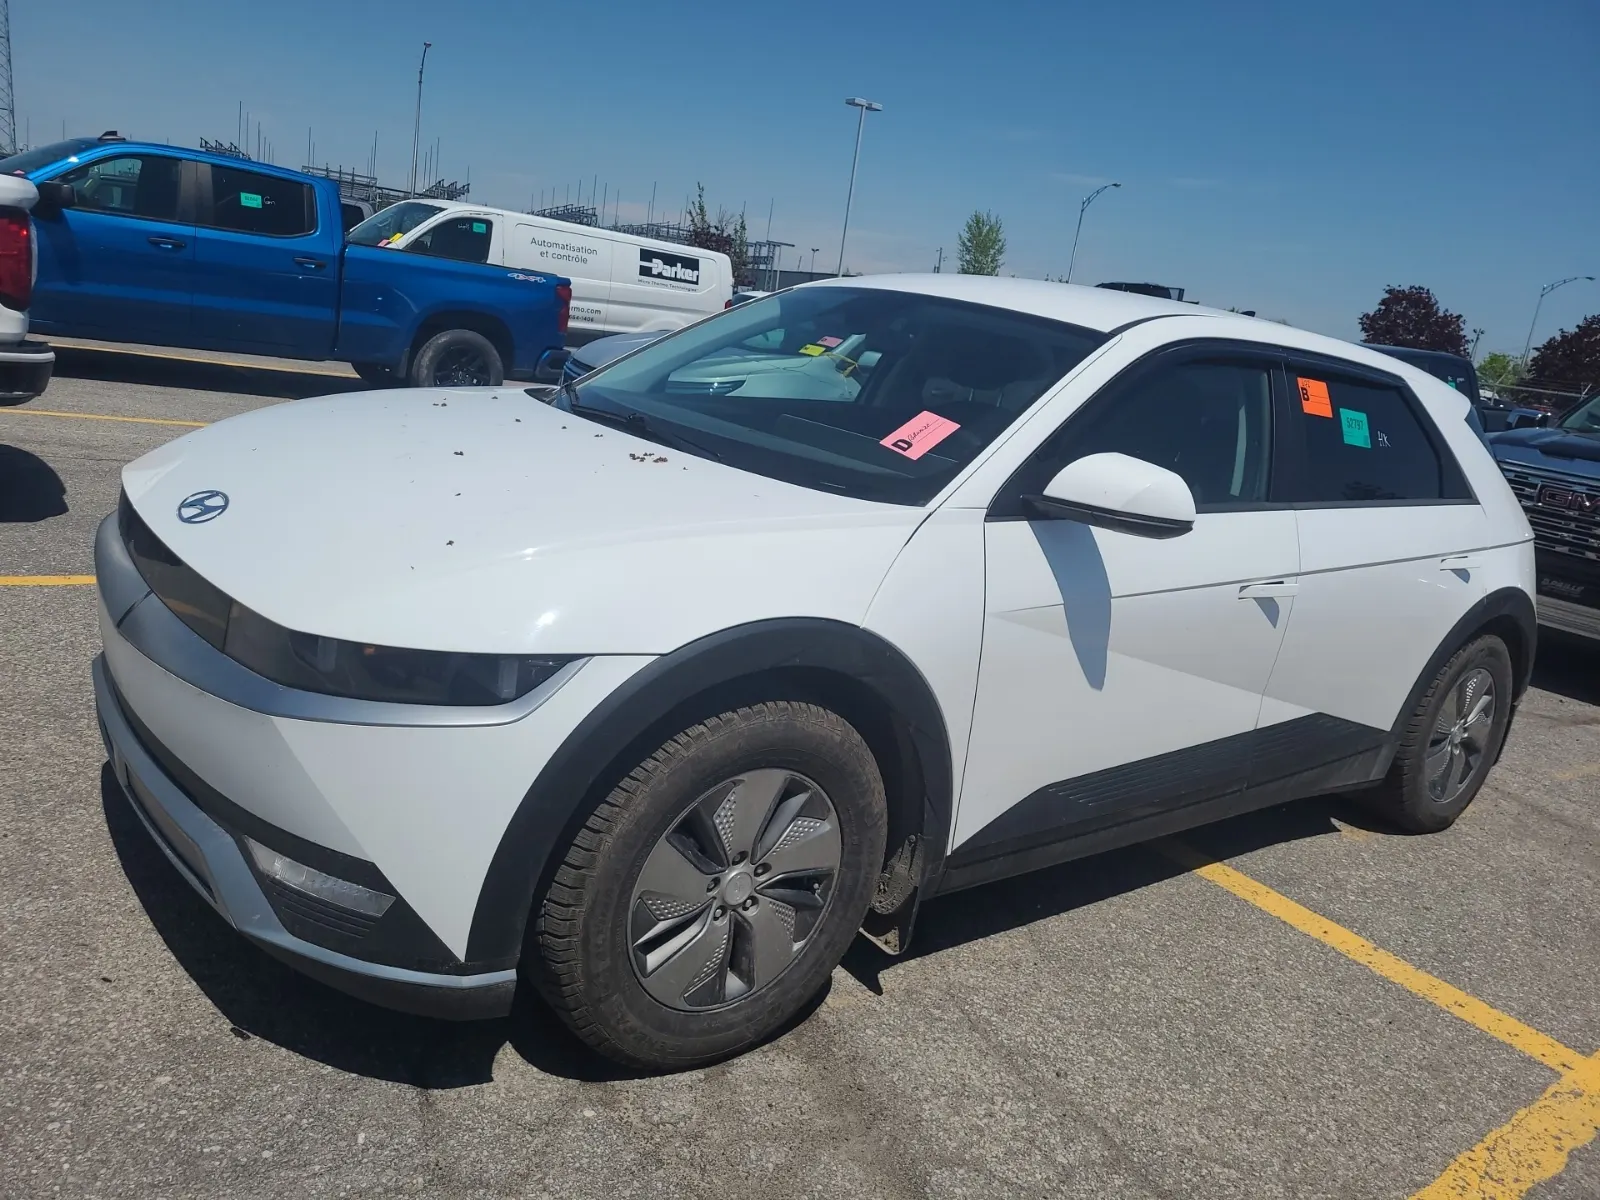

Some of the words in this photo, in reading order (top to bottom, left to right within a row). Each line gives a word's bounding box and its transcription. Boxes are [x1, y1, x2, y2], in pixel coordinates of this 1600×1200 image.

[530, 237, 598, 256] Automatisation
[551, 252, 588, 265] contrôle
[650, 258, 699, 282] Parker
[651, 280, 669, 288] Thermo
[1300, 387, 1310, 401] B
[1346, 417, 1364, 430] 52797
[891, 439, 913, 452] D
